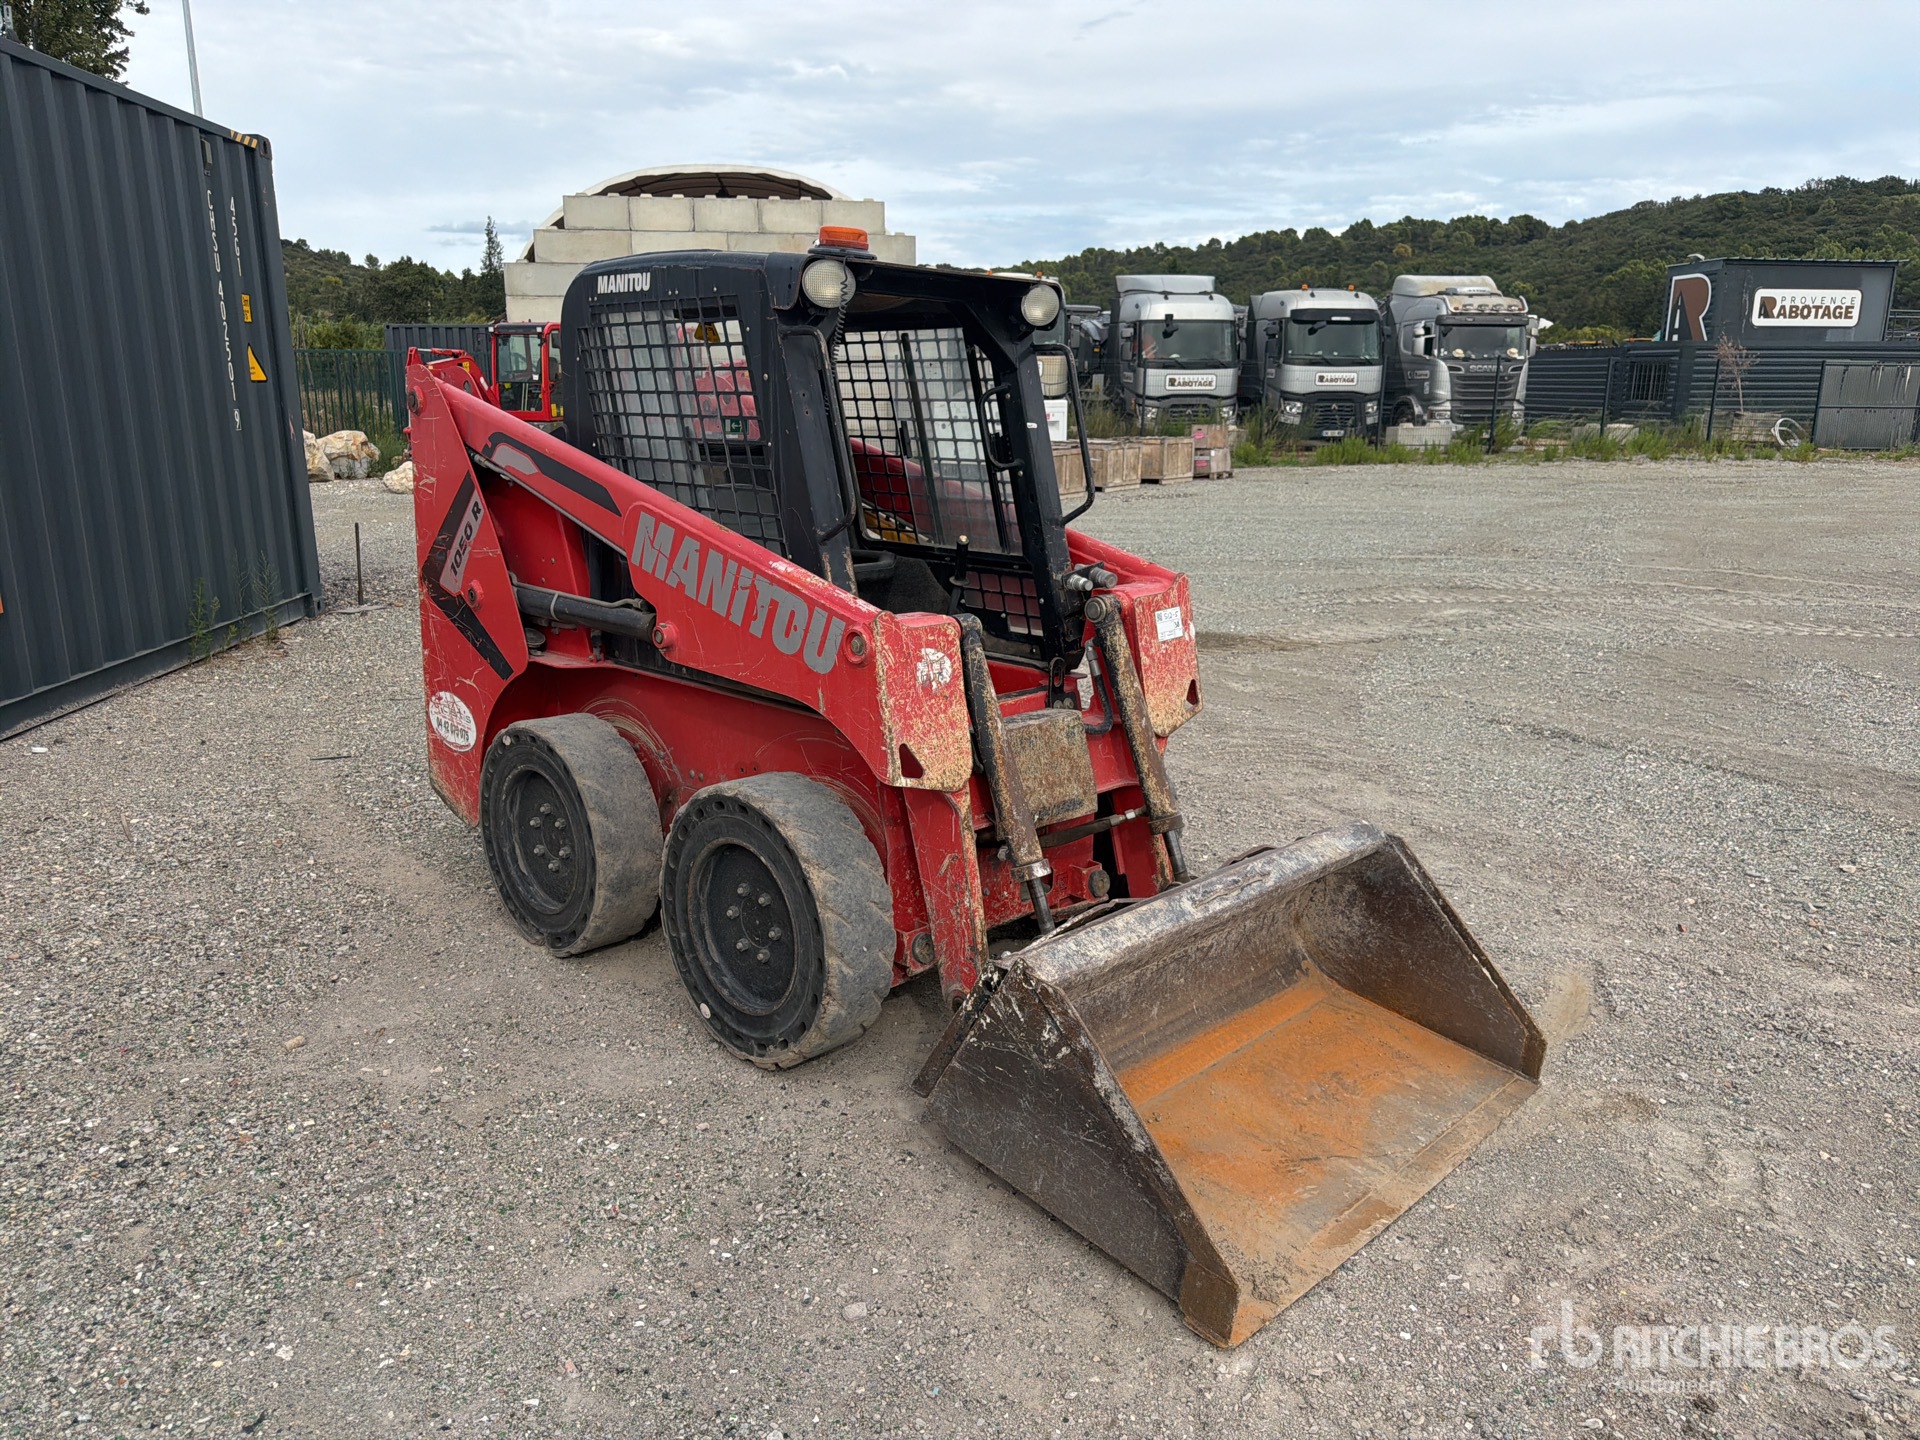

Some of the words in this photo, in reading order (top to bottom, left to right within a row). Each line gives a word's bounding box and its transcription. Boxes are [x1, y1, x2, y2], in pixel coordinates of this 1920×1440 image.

[207, 189, 221, 273] CHSU
[597, 271, 651, 294] MANITOU
[1780, 296, 1857, 305] PROVENCE
[450, 521, 473, 577] 1050
[471, 501, 482, 522] R
[631, 511, 846, 675] MANITOU
